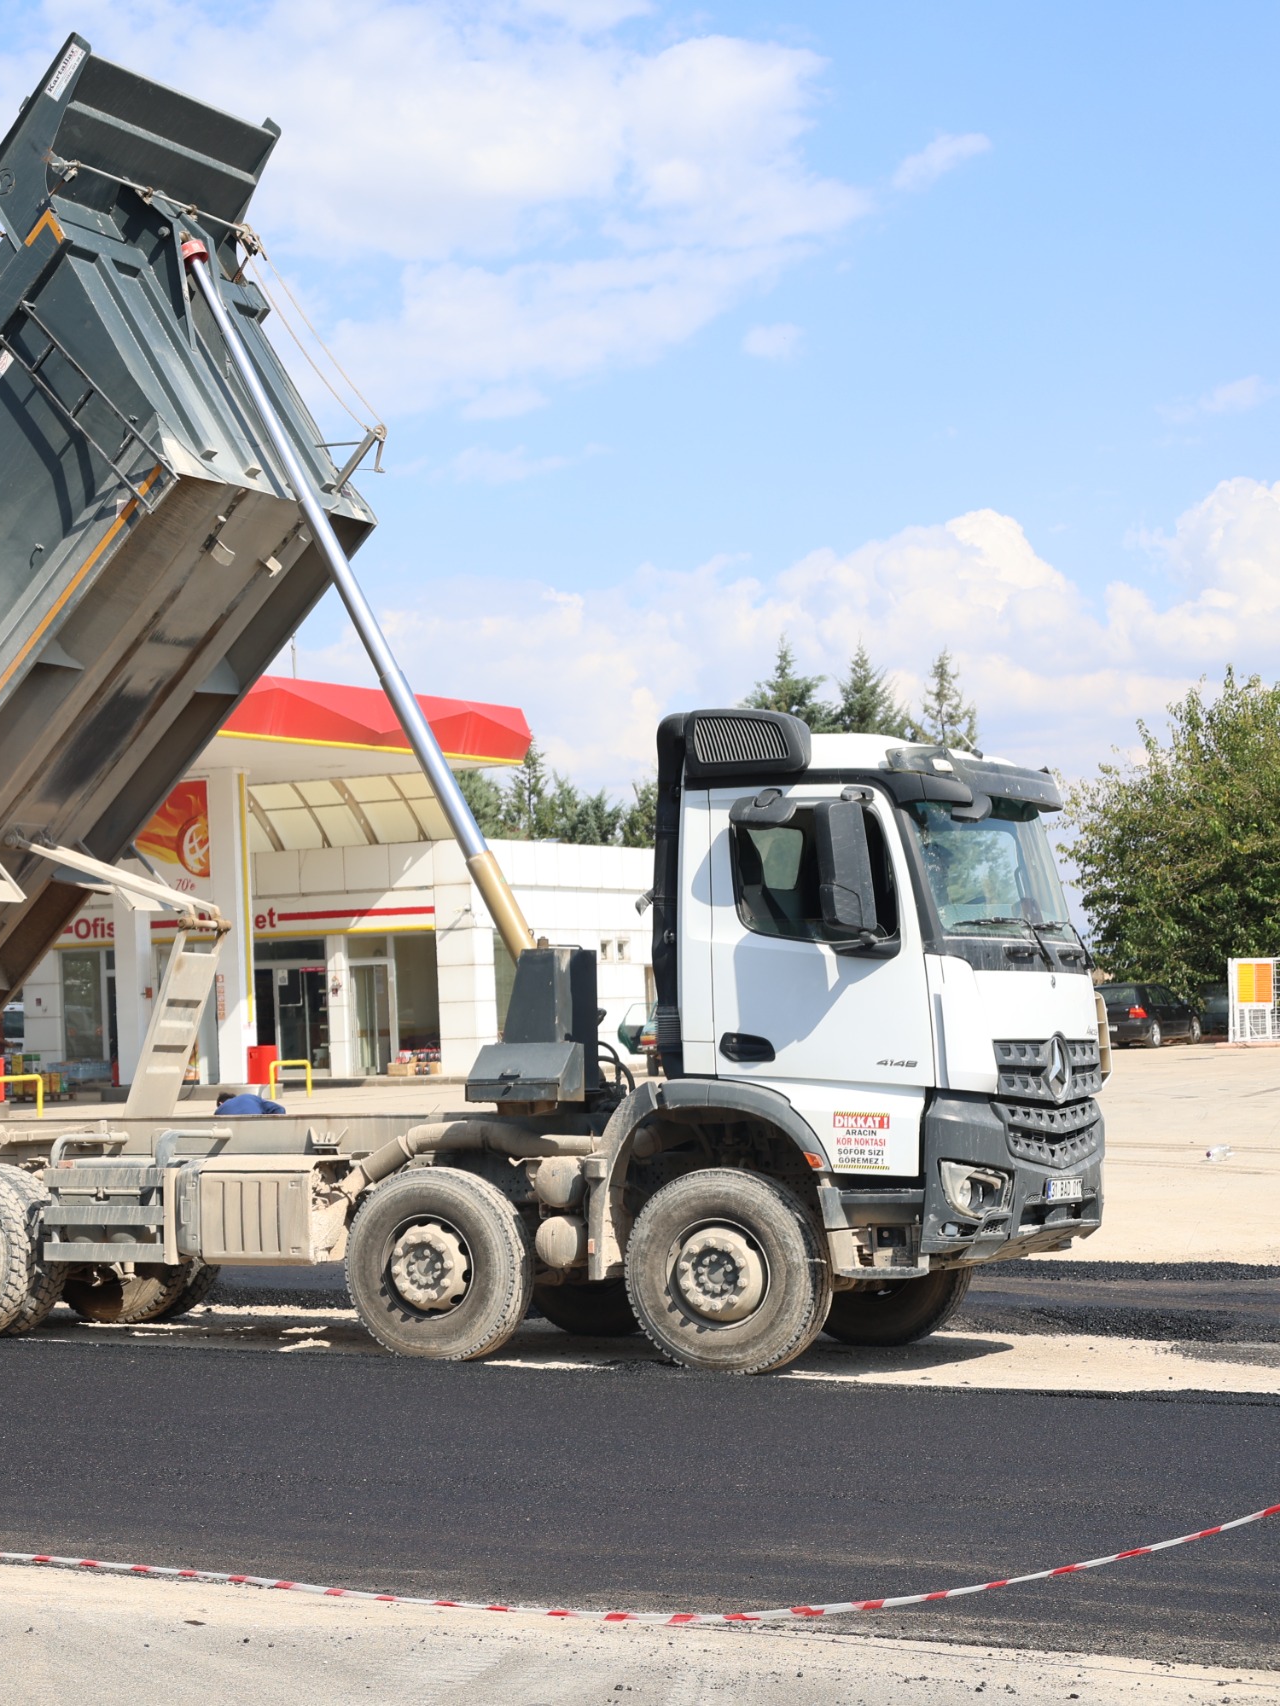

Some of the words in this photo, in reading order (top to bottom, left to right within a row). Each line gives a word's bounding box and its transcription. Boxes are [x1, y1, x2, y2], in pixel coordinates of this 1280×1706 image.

[47, 48, 75, 93] Kartallar
[74, 917, 114, 939] Ofis
[834, 1115, 881, 1128] DİKKAT
[883, 1116, 888, 1128] !
[854, 1138, 886, 1147] NOKTASI
[868, 1148, 884, 1156] SİZİ
